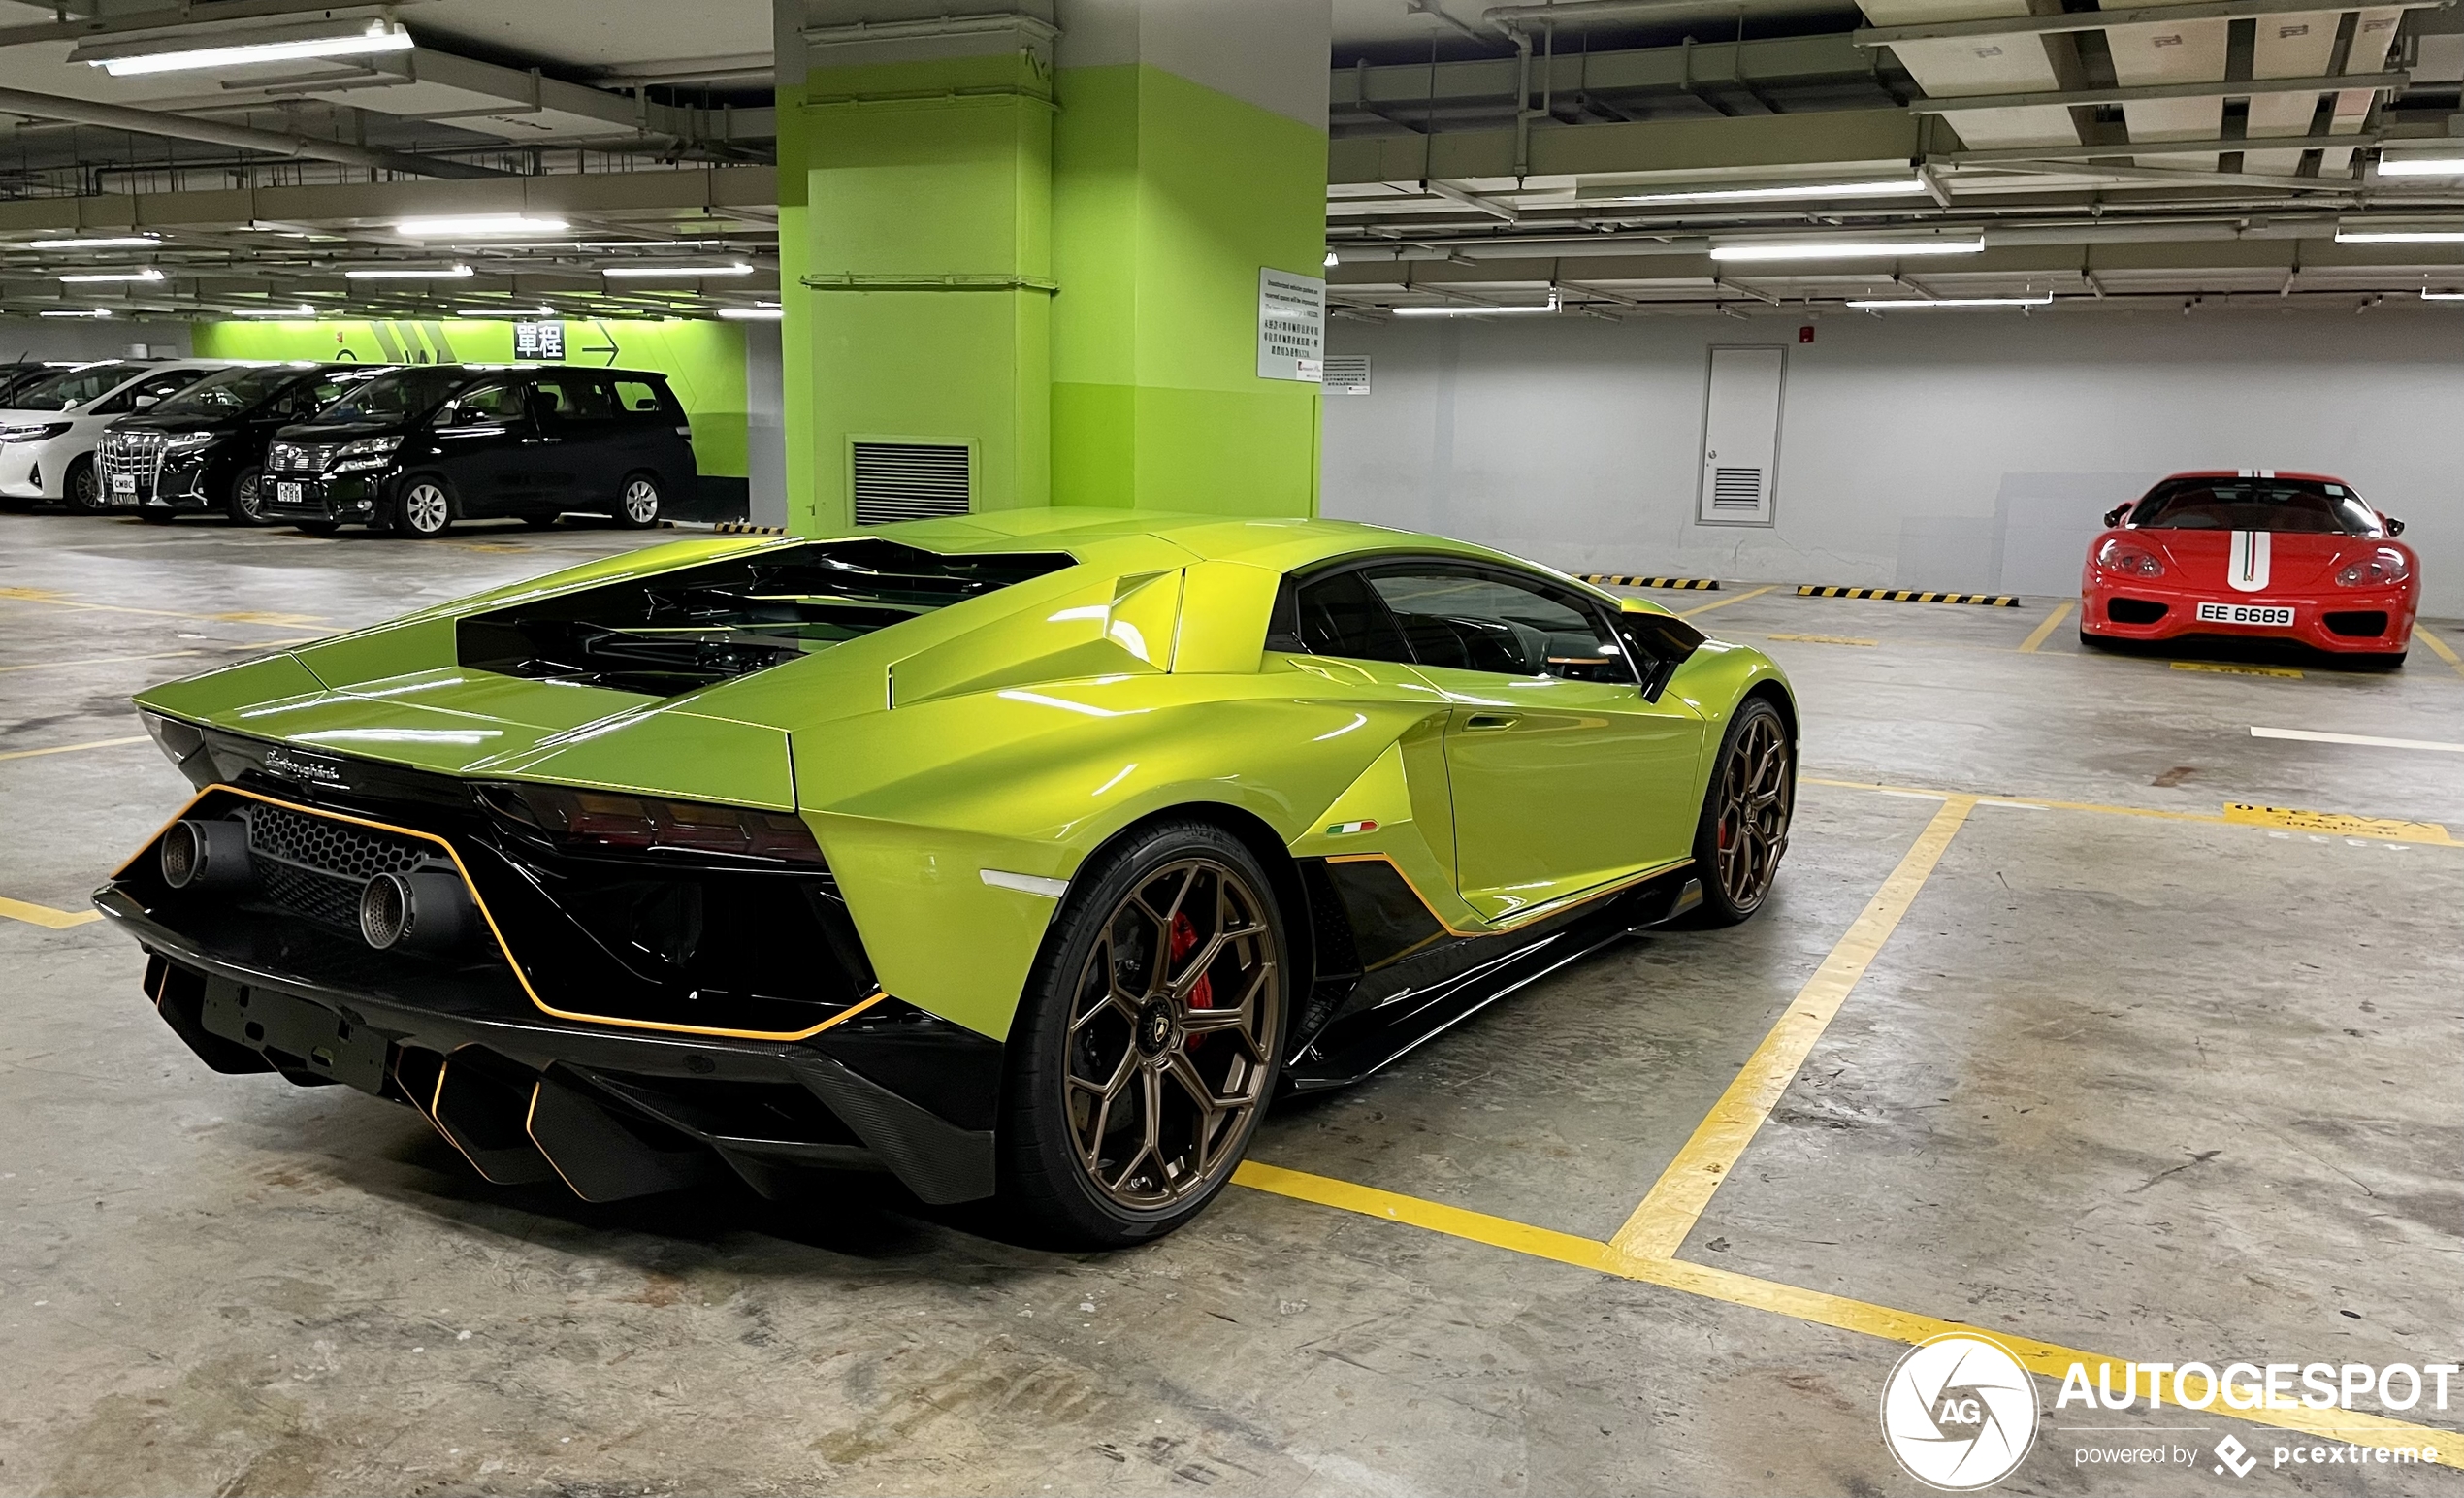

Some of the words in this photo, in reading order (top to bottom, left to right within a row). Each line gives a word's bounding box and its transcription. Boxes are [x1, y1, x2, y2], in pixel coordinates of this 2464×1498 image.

[517, 321, 563, 358] 單程
[2201, 604, 2228, 620] EE
[2234, 607, 2289, 624] 6689
